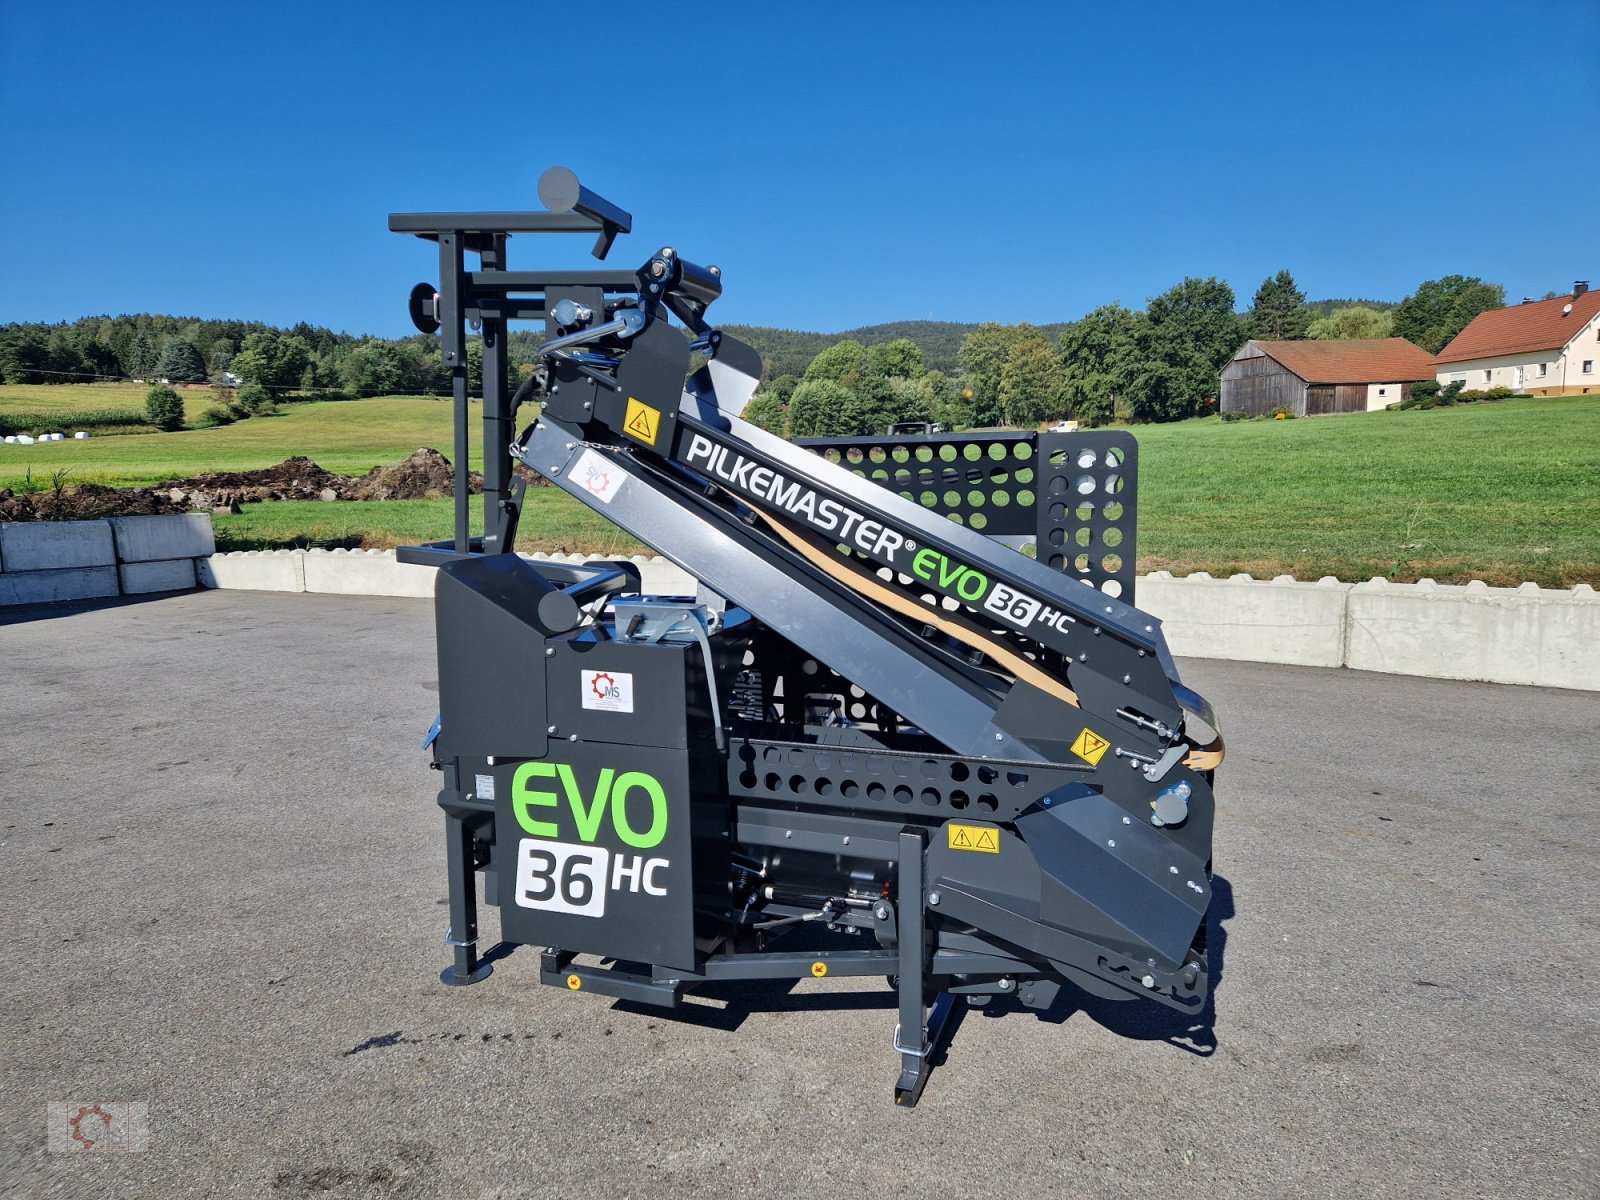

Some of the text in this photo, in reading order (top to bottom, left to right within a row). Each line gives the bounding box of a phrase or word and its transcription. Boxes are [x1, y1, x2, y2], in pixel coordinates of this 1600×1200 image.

[912, 548, 988, 601] EVO
[990, 588, 1033, 620] 36
[1037, 606, 1076, 634] HC
[511, 761, 668, 849] EVO
[525, 848, 670, 907] 36 HC
